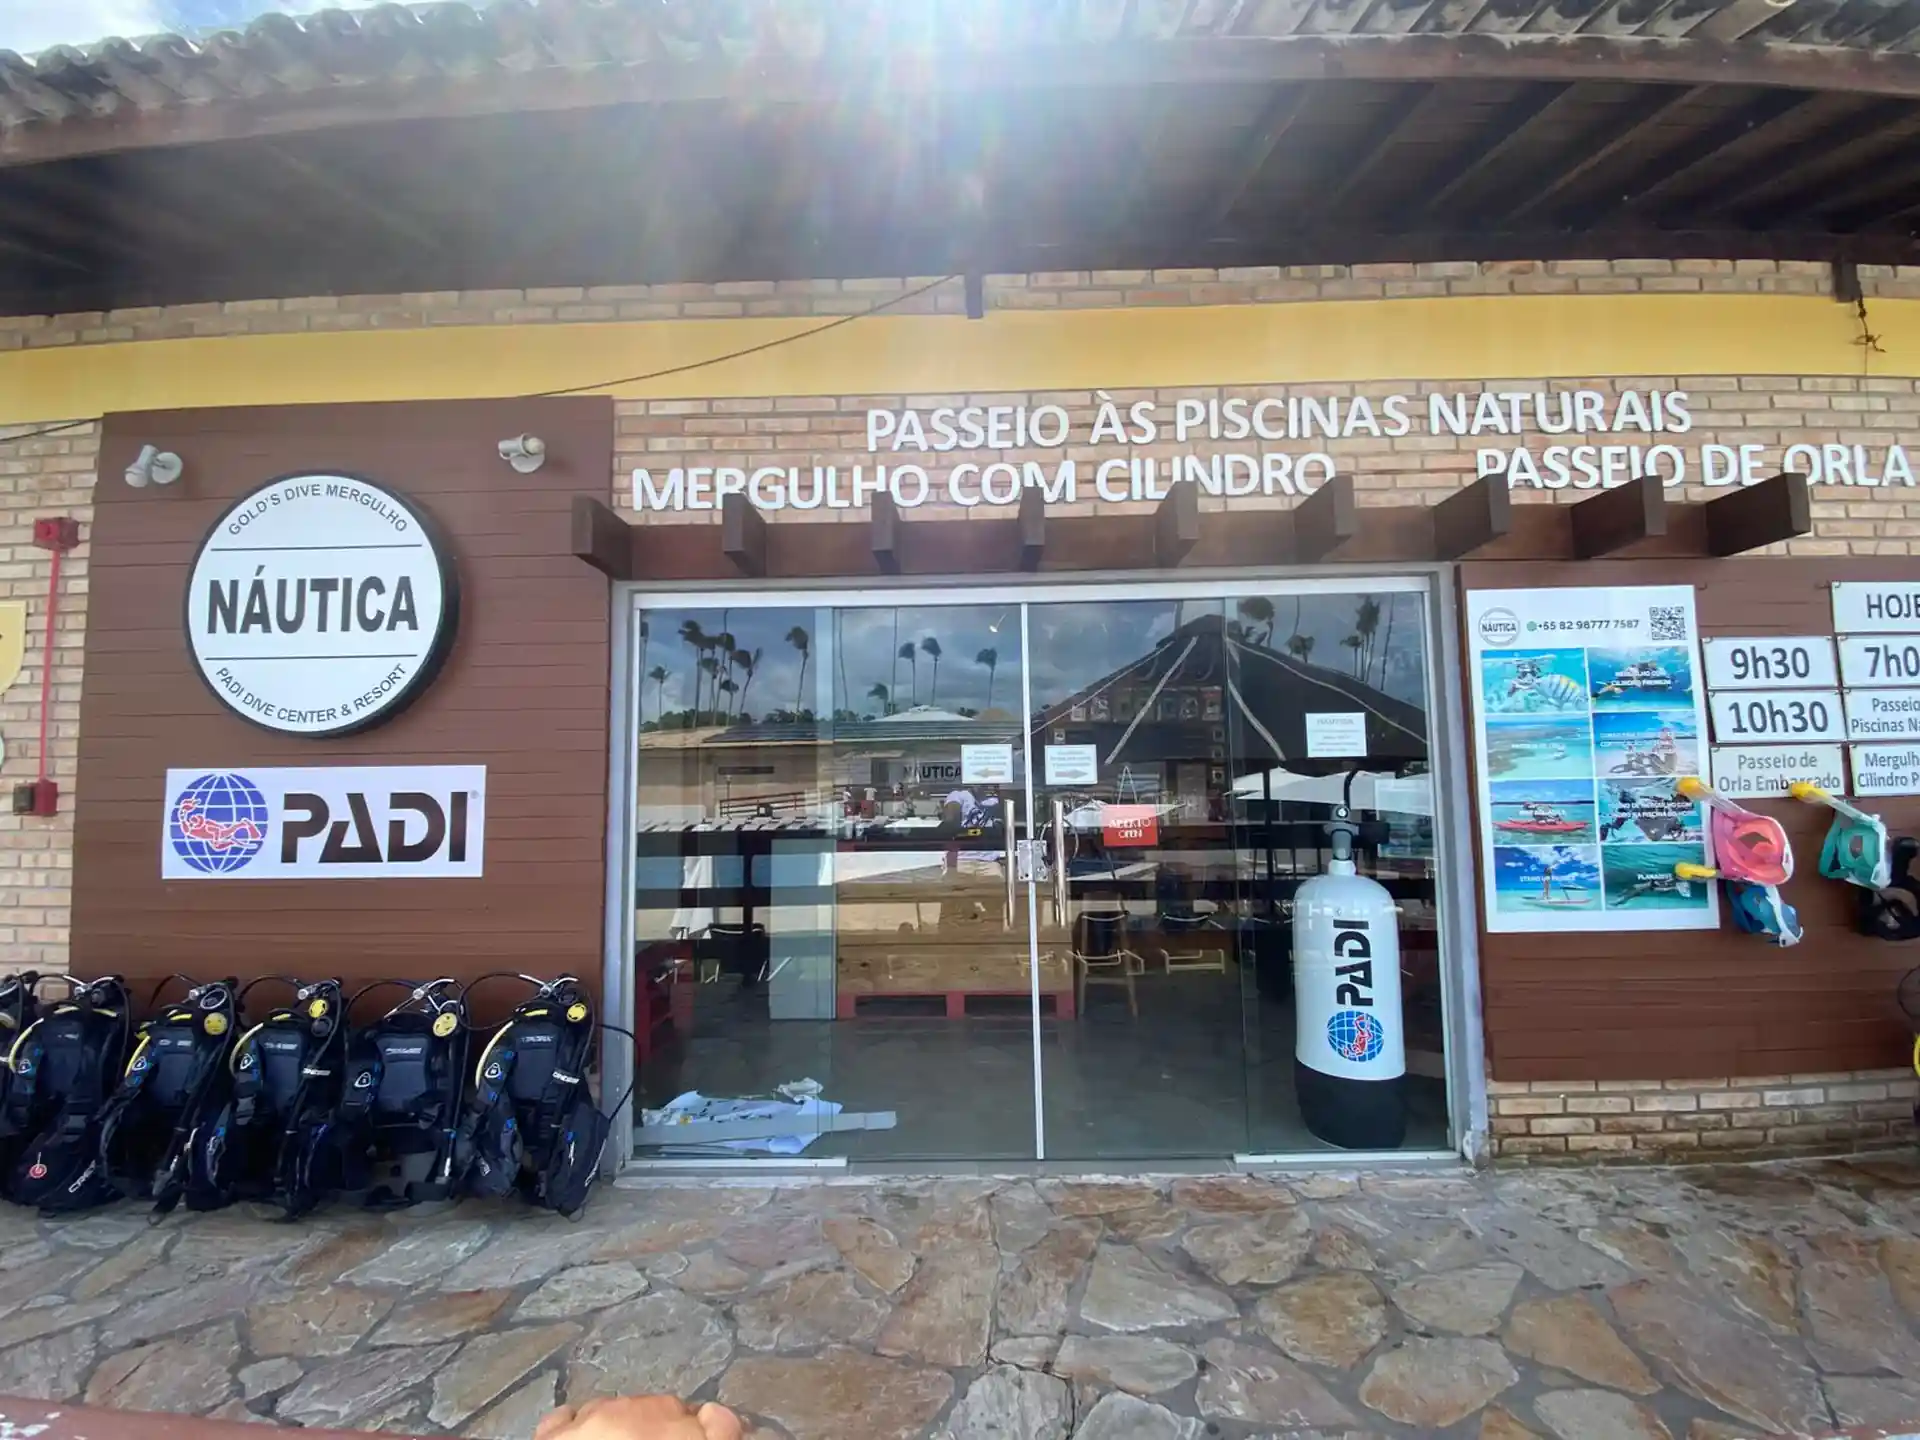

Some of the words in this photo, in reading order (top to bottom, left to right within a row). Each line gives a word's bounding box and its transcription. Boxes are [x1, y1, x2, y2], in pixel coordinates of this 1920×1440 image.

[867, 405, 1069, 452] PASSEIO
[1089, 390, 1156, 445] ÀS
[1176, 394, 1410, 442] PISCINAS
[1429, 390, 1692, 435] NATURAIS
[632, 464, 929, 511] MERGULHO
[948, 460, 1077, 506] COM
[1096, 452, 1336, 501] CILINDRO
[1476, 444, 1685, 489] PASSEIO
[1701, 444, 1765, 487] DE
[1783, 443, 1916, 488] ORLA
[228, 492, 281, 535] GOLD'S
[284, 484, 320, 501] DIVE
[326, 484, 407, 532] MERGULHO
[206, 564, 418, 635] NÁUTICA
[1559, 621, 1573, 630] 82
[1576, 620, 1610, 630] 98777
[1613, 619, 1639, 629] 7587
[1730, 645, 1810, 680] 9h30
[216, 667, 245, 698] PADI
[242, 692, 276, 717] DIVE
[277, 707, 338, 723] CENTER
[340, 703, 352, 717] &
[353, 663, 406, 711] RESORT
[1727, 700, 1829, 733] 10h30
[1851, 718, 1905, 733] Piscinas
[1738, 754, 1796, 770] Passeio
[1800, 751, 1818, 768] de
[1857, 771, 1908, 788] Cilindro
[1719, 776, 1752, 792] Orla
[281, 791, 469, 864] PADI
[1332, 919, 1374, 1007] PADI
